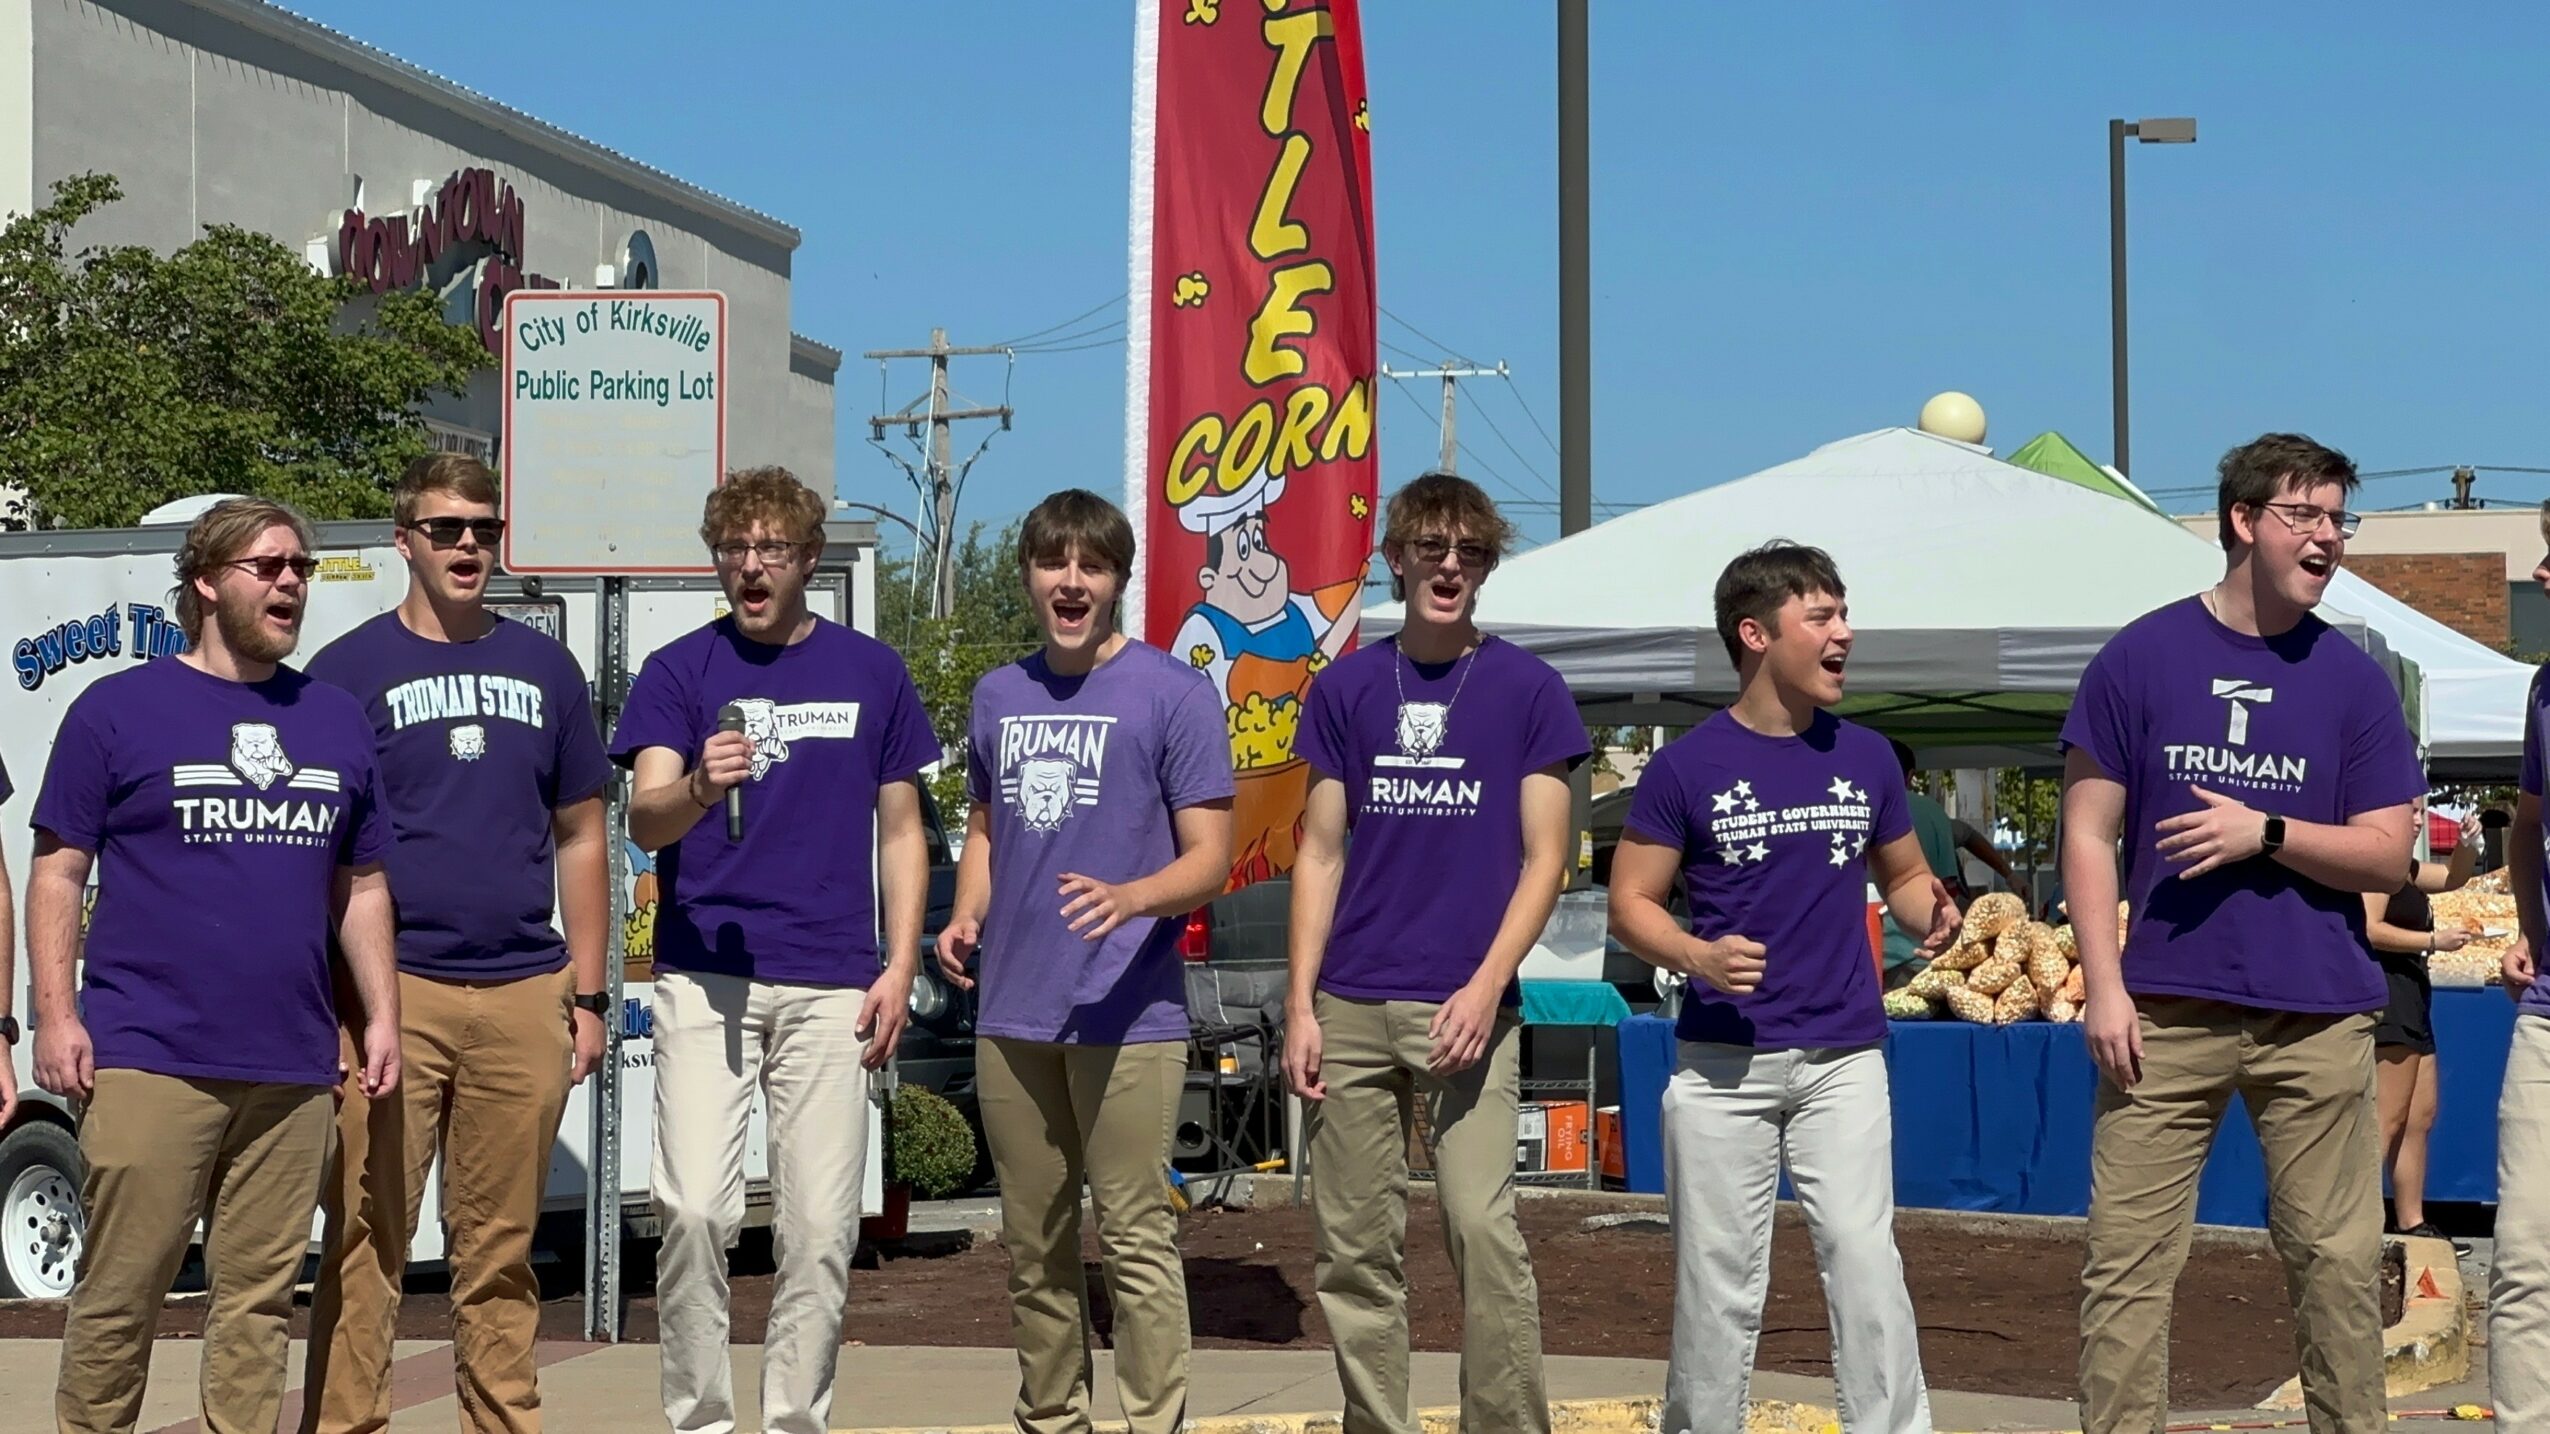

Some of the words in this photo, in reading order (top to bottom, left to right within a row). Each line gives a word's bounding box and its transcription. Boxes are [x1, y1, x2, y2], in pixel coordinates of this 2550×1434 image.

[1243, 0, 1336, 387] TLE
[339, 166, 525, 295] DOWNTOWN
[519, 316, 566, 352] City
[576, 301, 598, 333] of
[610, 300, 711, 353] Kirksville
[515, 370, 580, 401] Public
[590, 370, 669, 407] Parking
[680, 370, 714, 400] Lot
[1165, 377, 1377, 507] CORN
[12, 601, 122, 691] Sweet
[385, 674, 478, 730] TRUMAN
[479, 674, 543, 729] STATE
[776, 711, 849, 728] TRUMAN
[1000, 715, 1118, 779] TRUMAN
[2164, 745, 2306, 783] TRUMAN
[1368, 777, 1482, 805] RUMAN
[2168, 773, 2208, 782] STATE
[2218, 775, 2301, 794] UNIVERSITY
[173, 798, 340, 835] TRUMAN
[1398, 807, 1477, 816] UNIVERSITY
[1711, 810, 1777, 832] STUDENT
[1782, 804, 1871, 820] GOVERNMENT
[184, 833, 233, 843] STATE
[244, 833, 329, 848] UNIVERSIT
[1715, 826, 1767, 843] TRUMAN
[1770, 823, 1807, 835] STATE
[1811, 819, 1870, 831] UNIVERSITY
[1557, 1127, 1566, 1149] OIL
[1564, 1114, 1574, 1161] FRYING
